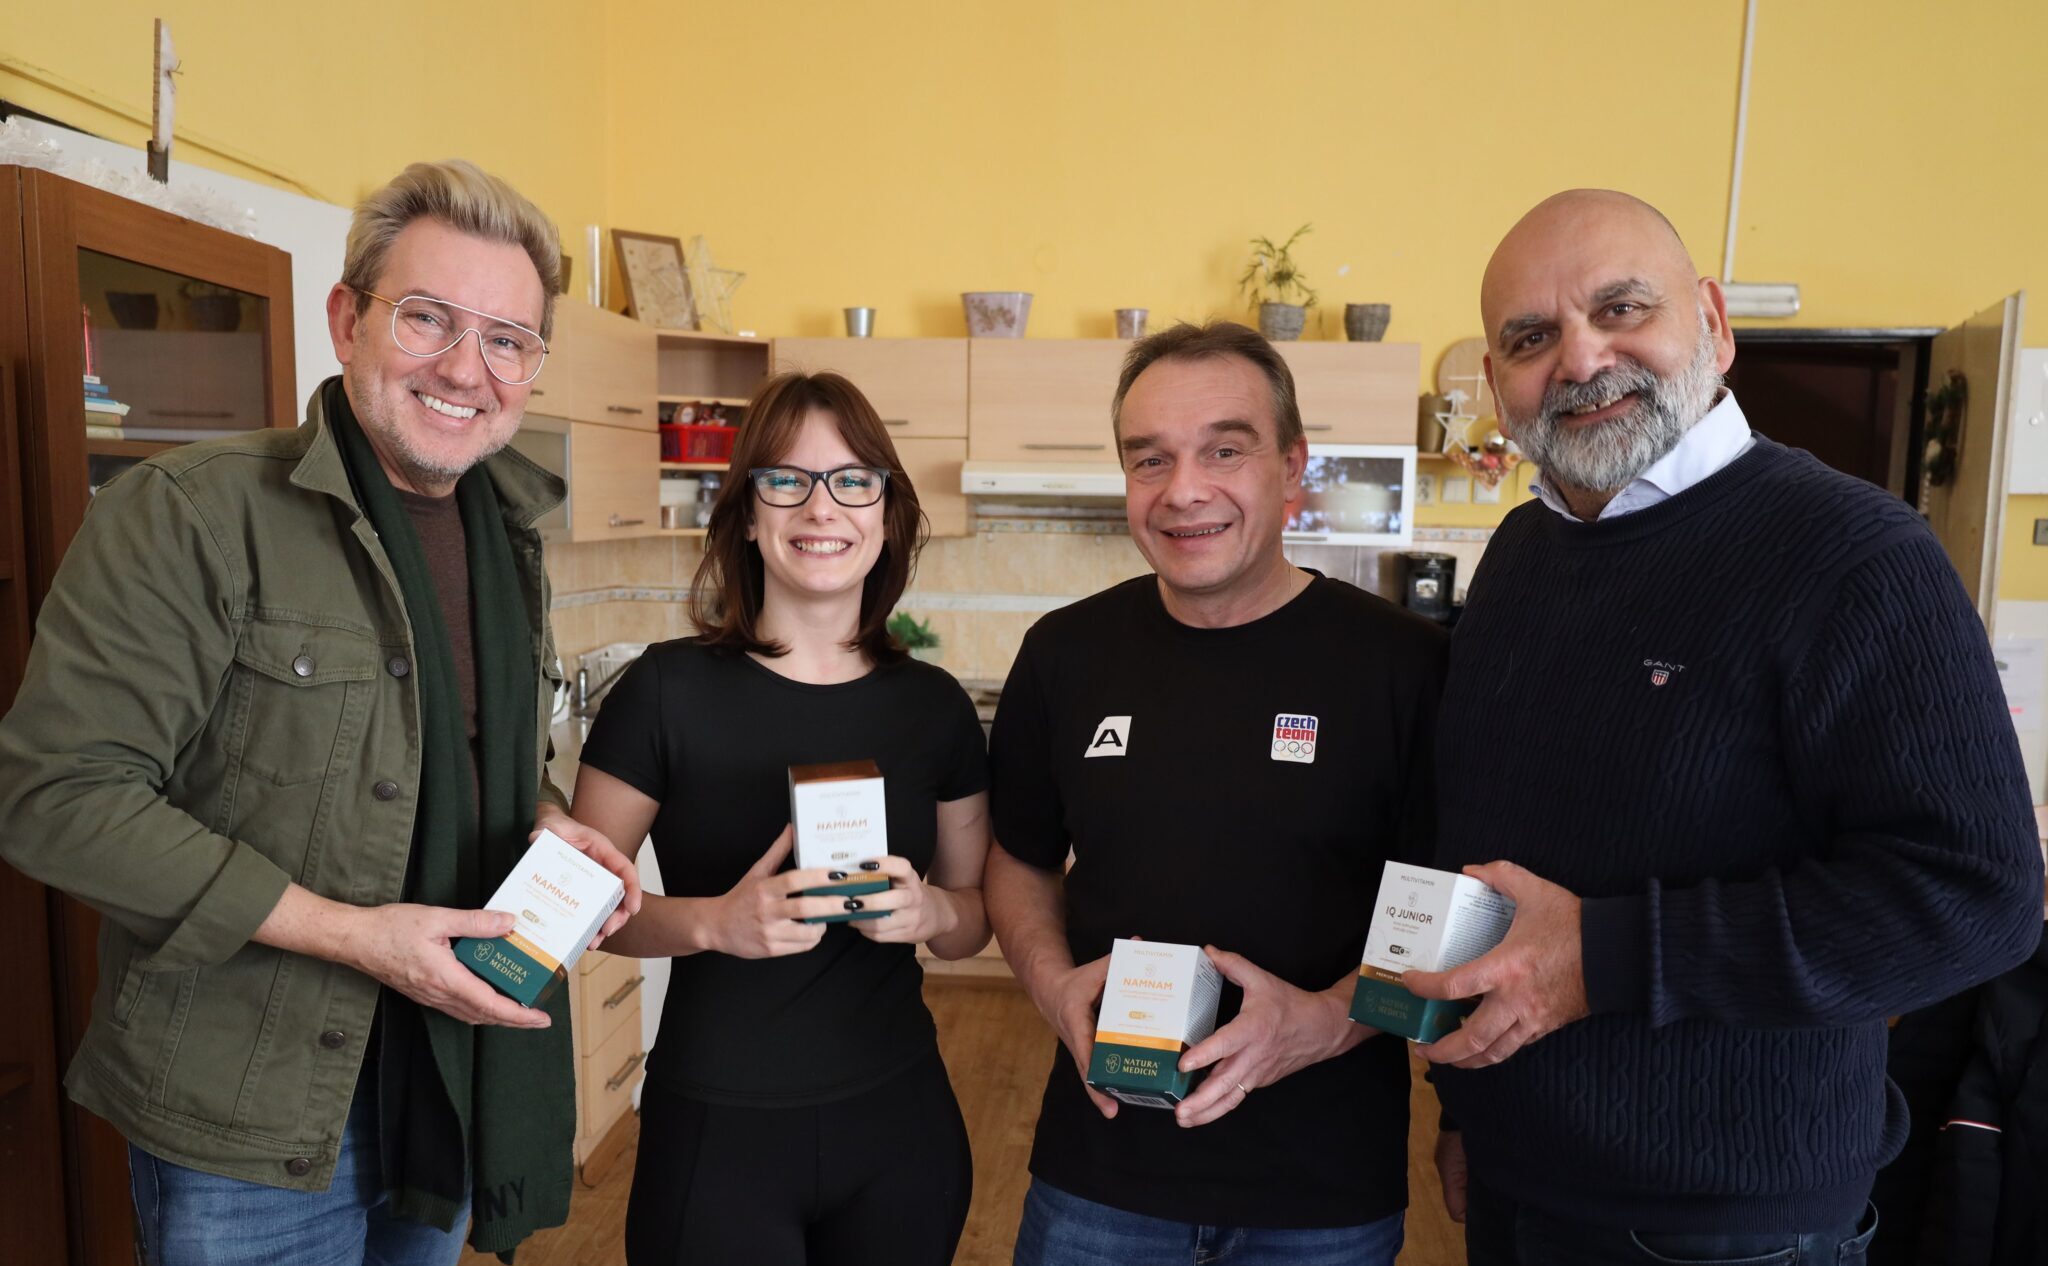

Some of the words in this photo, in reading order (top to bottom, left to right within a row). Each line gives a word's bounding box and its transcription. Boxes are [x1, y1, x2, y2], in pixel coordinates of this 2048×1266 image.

[1643, 659, 1686, 672] GANT
[1277, 716, 1316, 730] czech
[1093, 728, 1123, 748] A
[1275, 728, 1315, 742] team
[1401, 874, 1435, 887] MULTIVITAMIN
[531, 872, 580, 909] NAMNAM
[1385, 905, 1396, 918] IQ
[1397, 908, 1433, 925] JUNIOR
[489, 958, 525, 985] MEDICIN
[494, 951, 528, 978] NATURA
[1123, 977, 1173, 991] NAMNAM
[1123, 1057, 1158, 1069] NATURA
[1122, 1065, 1158, 1077] MEDICIN
